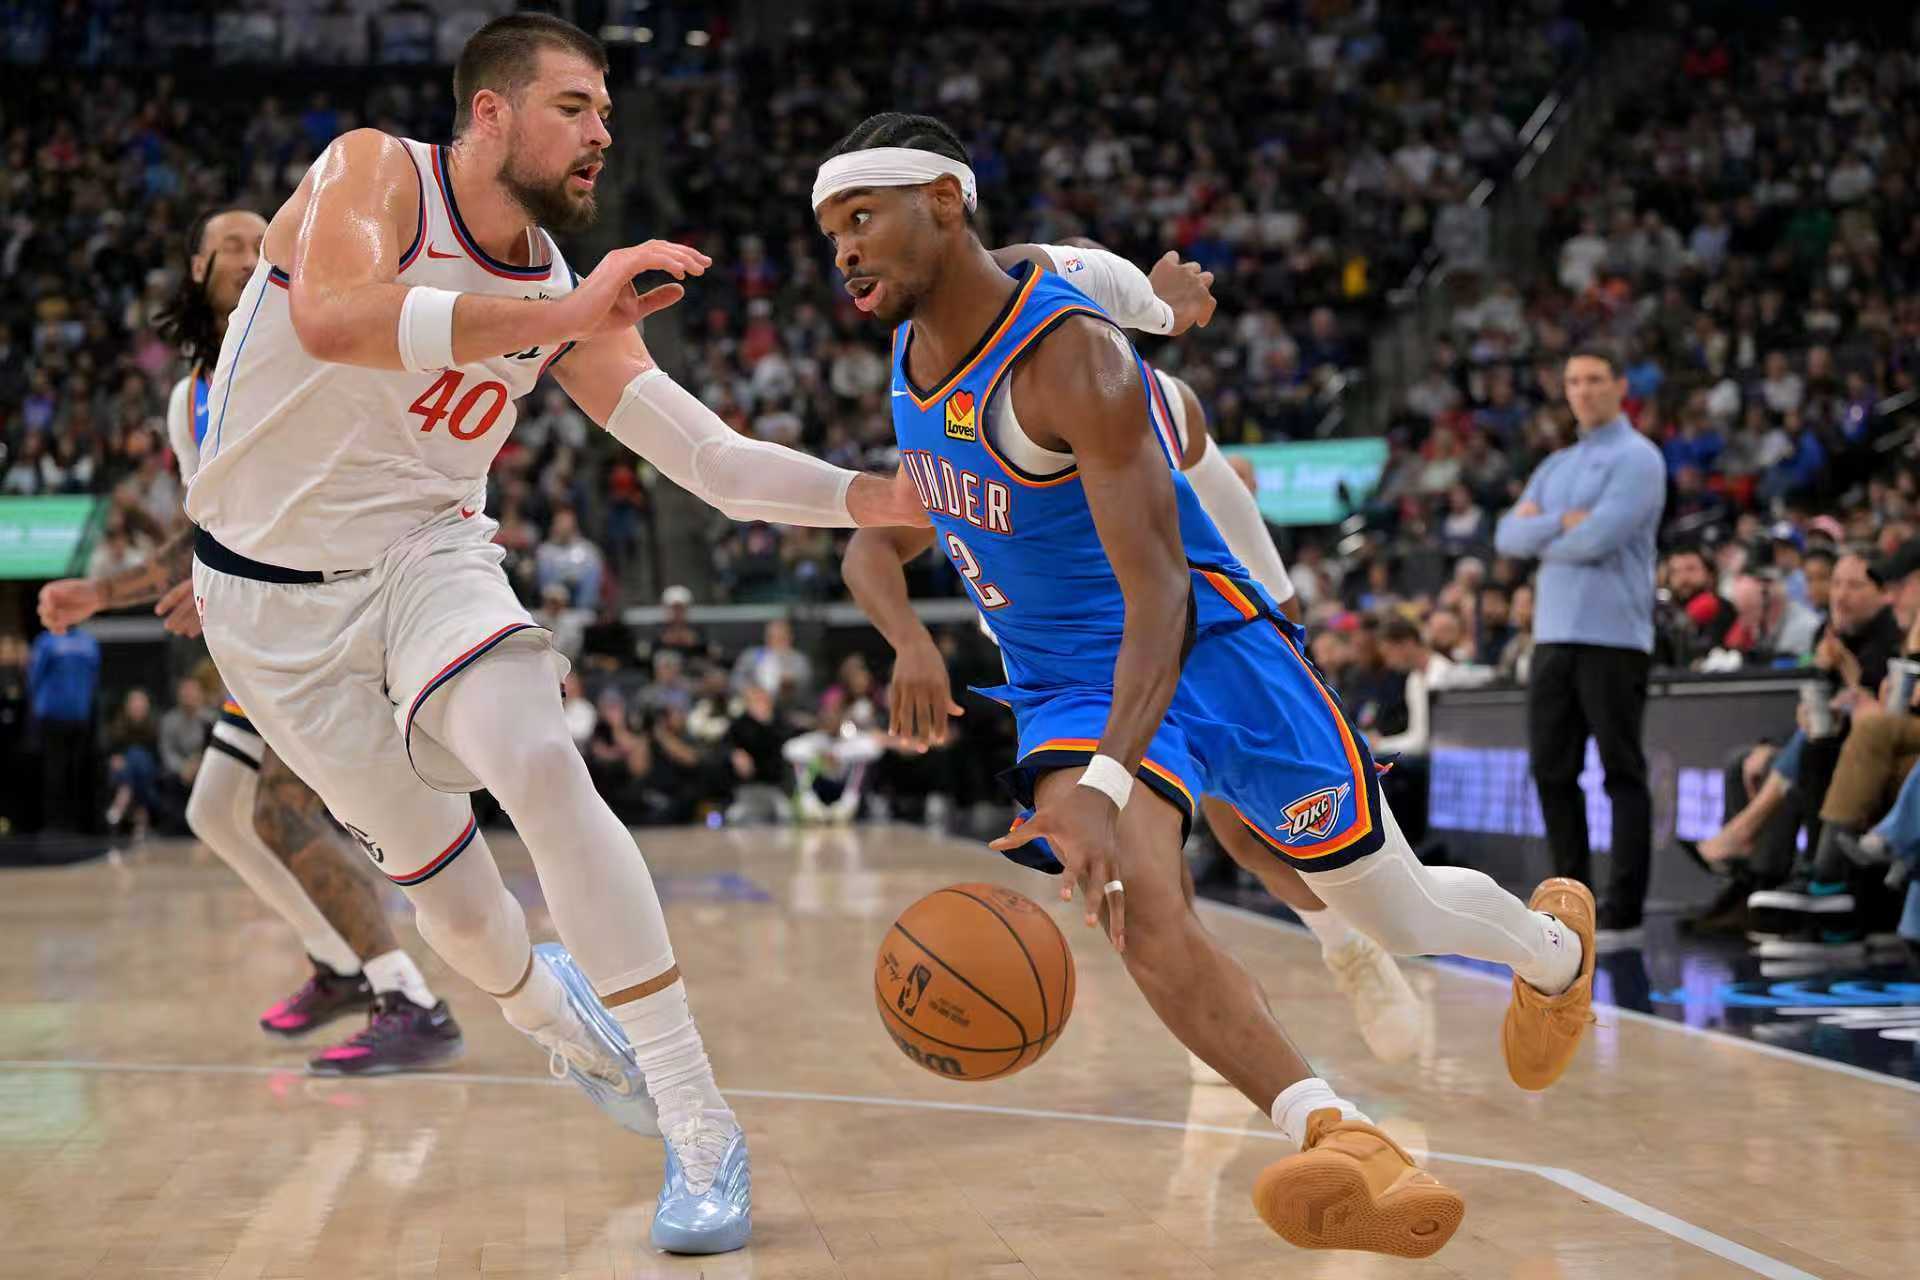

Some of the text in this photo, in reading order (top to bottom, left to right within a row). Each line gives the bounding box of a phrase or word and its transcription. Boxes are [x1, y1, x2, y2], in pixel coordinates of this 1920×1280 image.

[408, 369, 508, 441] 40
[903, 449, 1014, 535] UNDER
[946, 531, 1012, 610] 2
[1292, 797, 1329, 834] OKC
